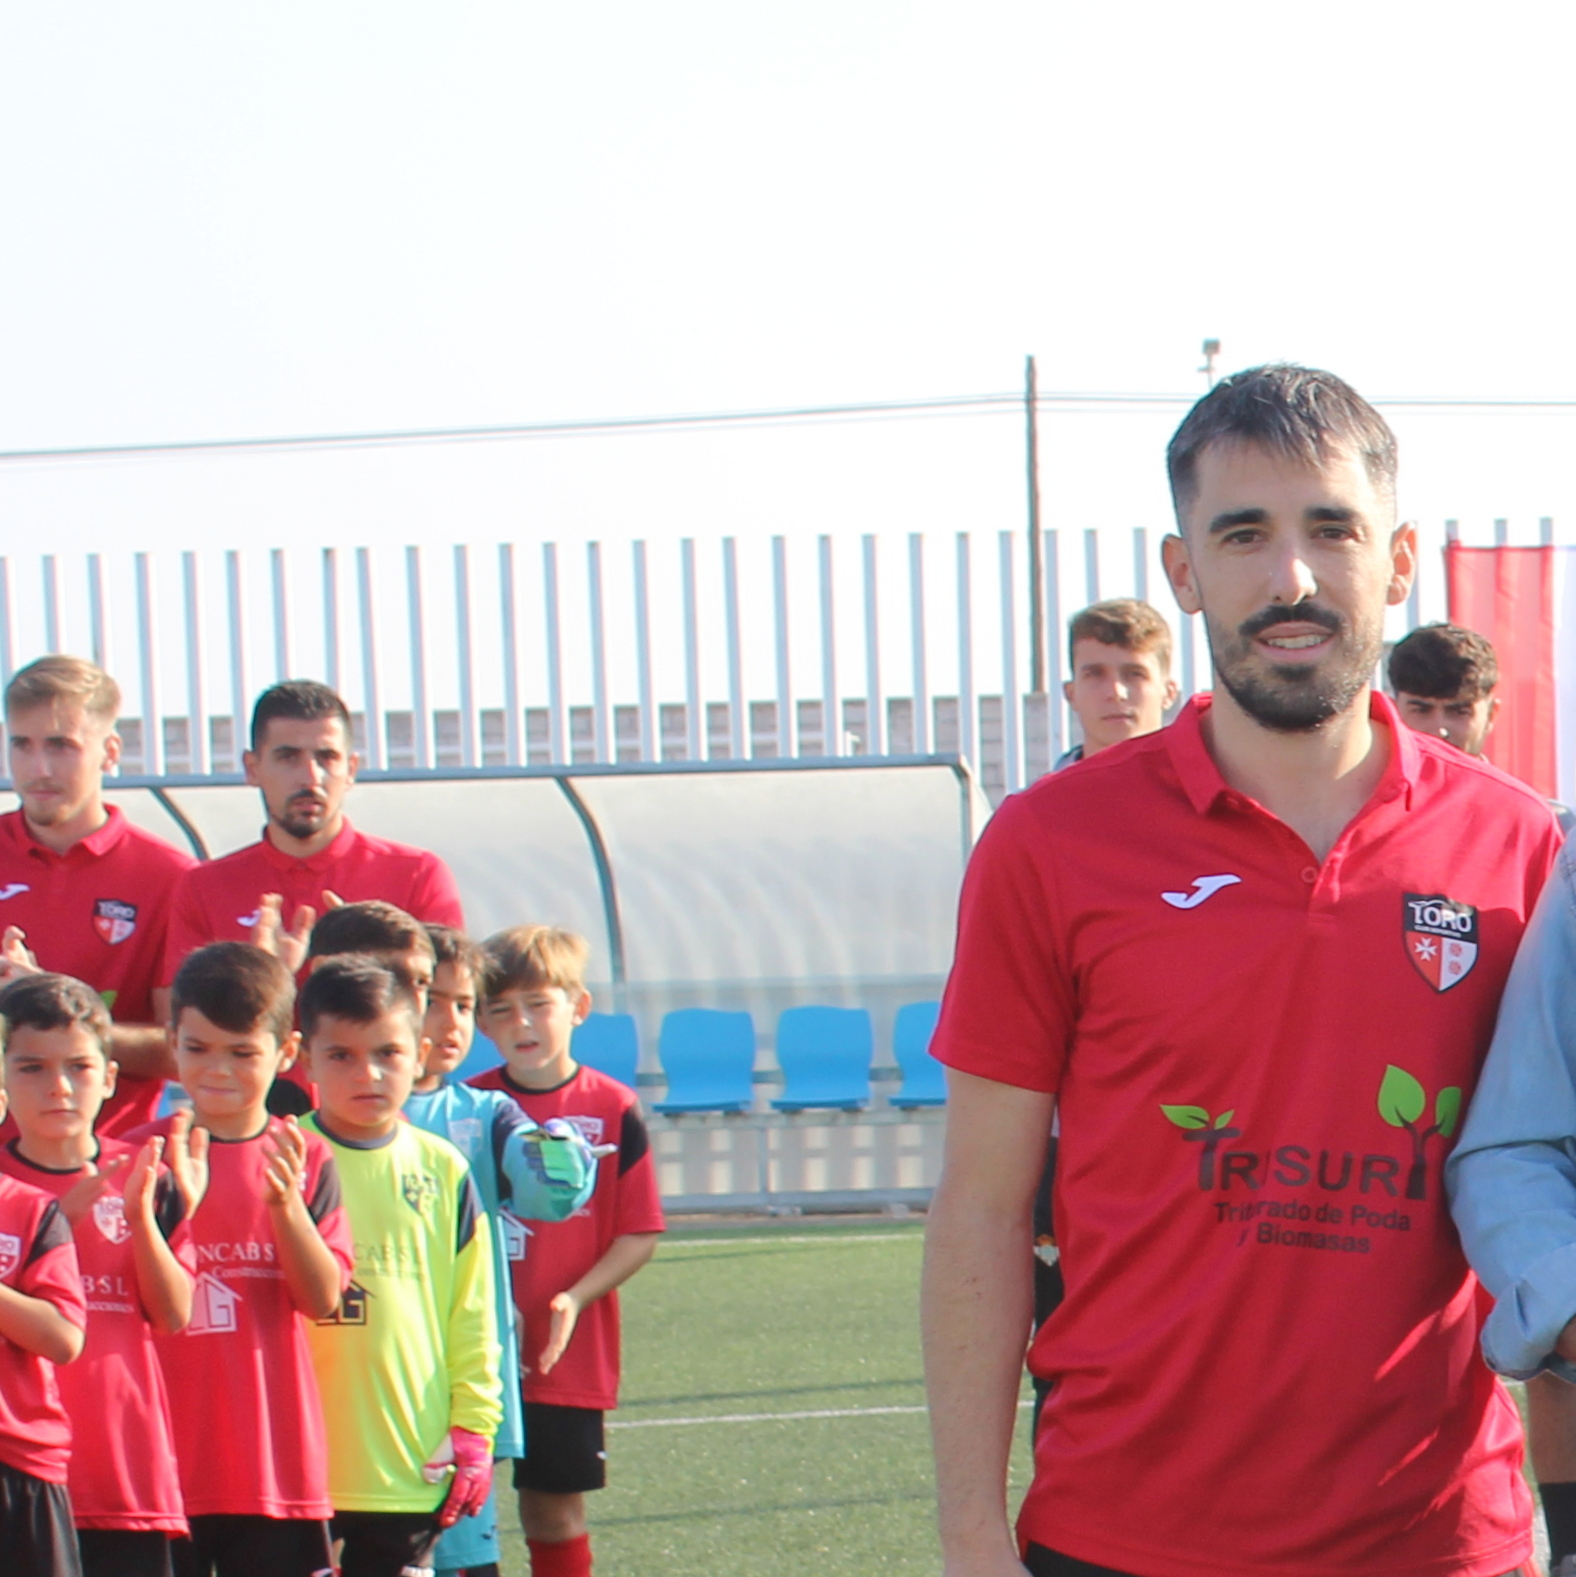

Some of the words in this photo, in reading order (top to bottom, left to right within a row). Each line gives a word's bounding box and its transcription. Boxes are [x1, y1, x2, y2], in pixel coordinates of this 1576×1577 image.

[1407, 899, 1472, 933] TORO
[1315, 1203, 1344, 1225] de
[1351, 1204, 1412, 1232] Poda
[196, 1242, 261, 1262] NCAB
[1257, 1222, 1371, 1254] Biomasas
